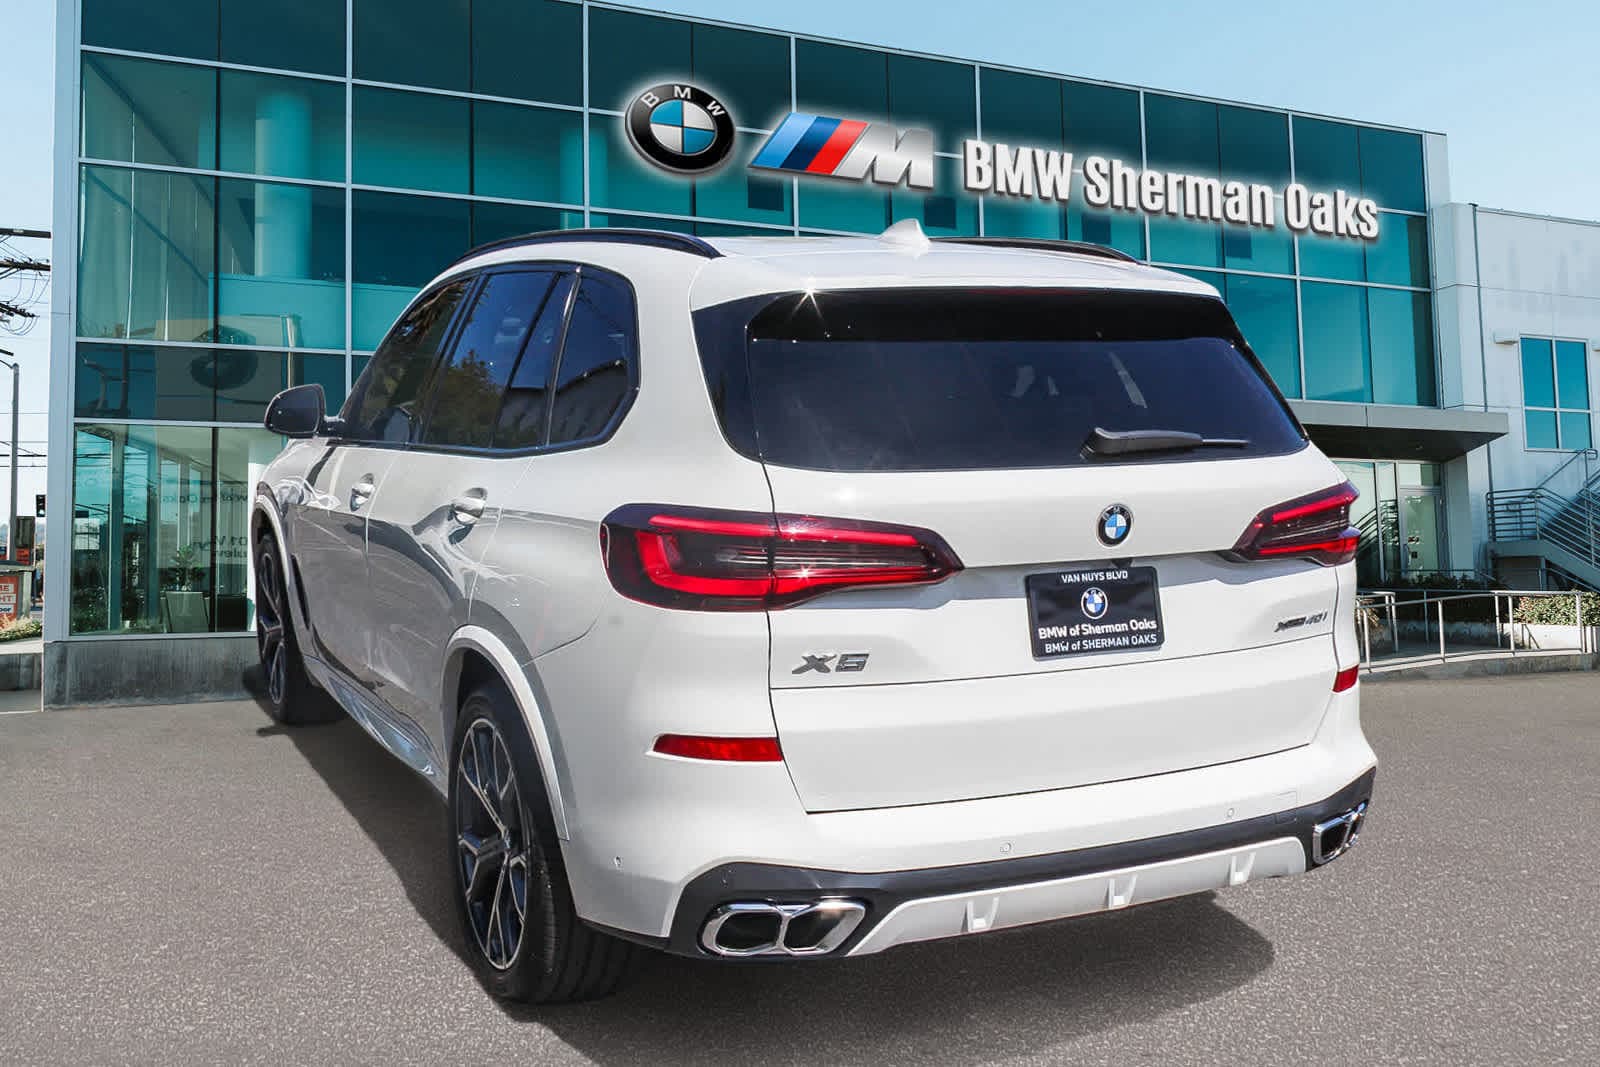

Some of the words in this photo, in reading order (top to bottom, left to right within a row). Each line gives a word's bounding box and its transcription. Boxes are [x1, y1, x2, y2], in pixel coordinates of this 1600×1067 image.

[640, 85, 725, 117] BMW
[963, 139, 1074, 201] BMW
[1083, 156, 1275, 227] Sherman
[1283, 183, 1380, 242] Oaks
[1061, 574, 1080, 584] VAN
[1081, 572, 1105, 582] NUYS
[1106, 570, 1128, 581] BLVD
[1038, 626, 1067, 640] BMW
[1069, 624, 1080, 636] of
[1081, 622, 1128, 636] Sherman
[1129, 618, 1157, 631] Oaks
[1045, 642, 1069, 654] BMW
[1071, 641, 1080, 651] of
[1082, 638, 1129, 650] SHERMAN
[1131, 633, 1157, 645] OAKS
